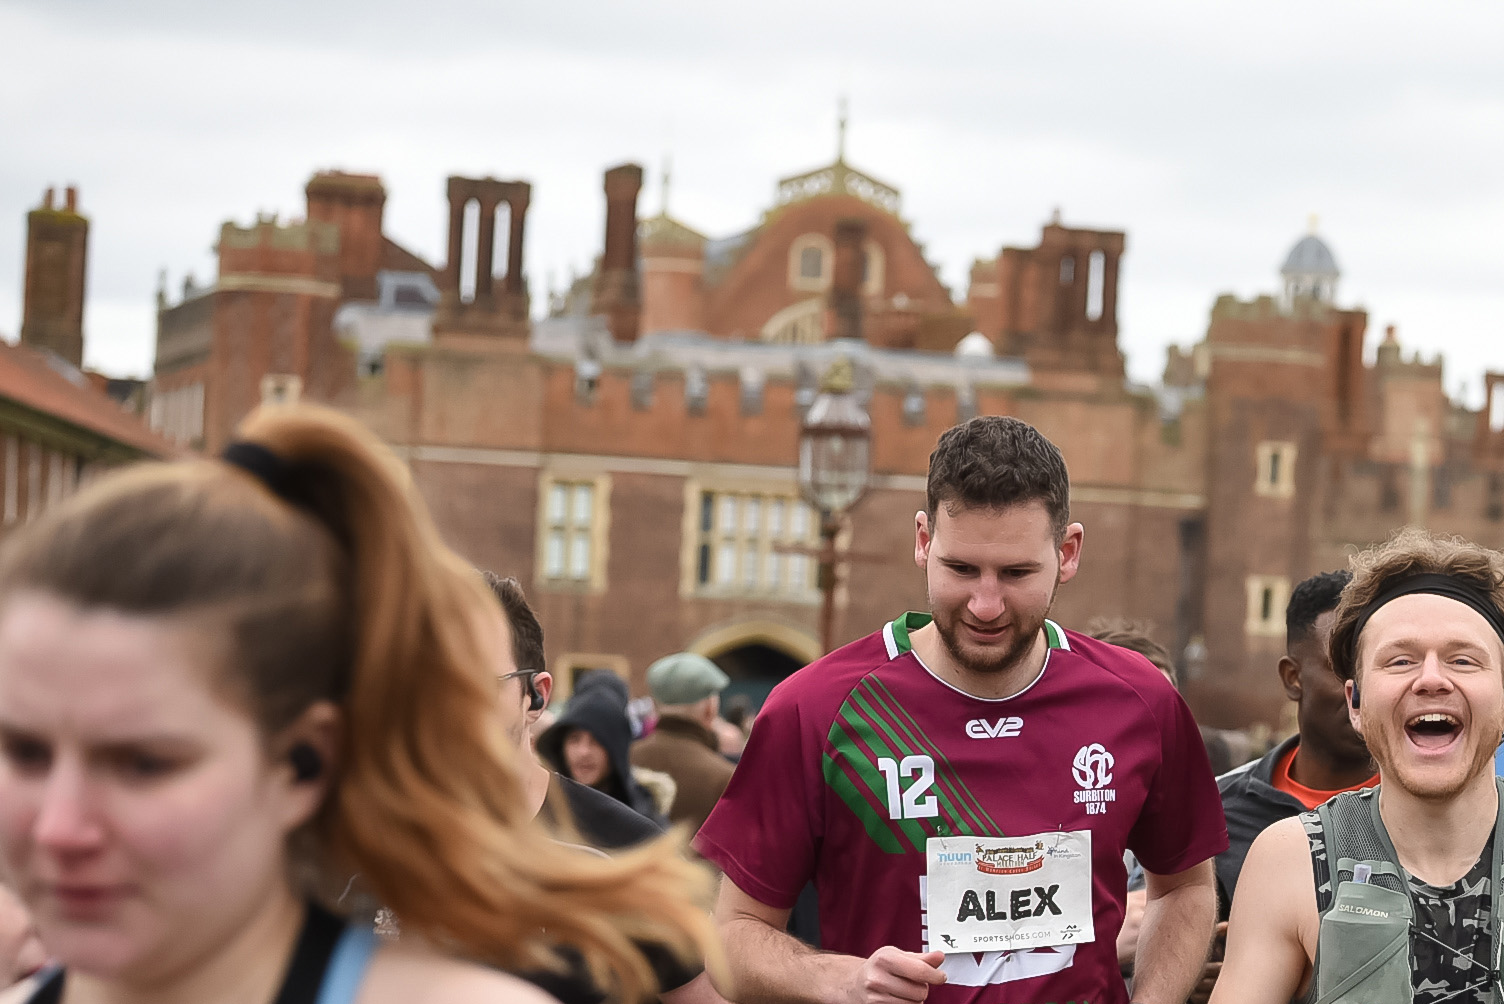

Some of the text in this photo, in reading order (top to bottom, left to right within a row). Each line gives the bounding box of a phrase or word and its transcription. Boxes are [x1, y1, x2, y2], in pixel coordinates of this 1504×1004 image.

[877, 755, 939, 820] 12
[1073, 789, 1116, 803] SURBITON
[1085, 802, 1107, 815] 1874
[937, 852, 972, 862] nuun
[982, 854, 1014, 862] PALACE
[956, 884, 1062, 922] ALEX
[1338, 904, 1389, 919] SALOMON
[973, 931, 1051, 943] SPORTSSHOES.COM
